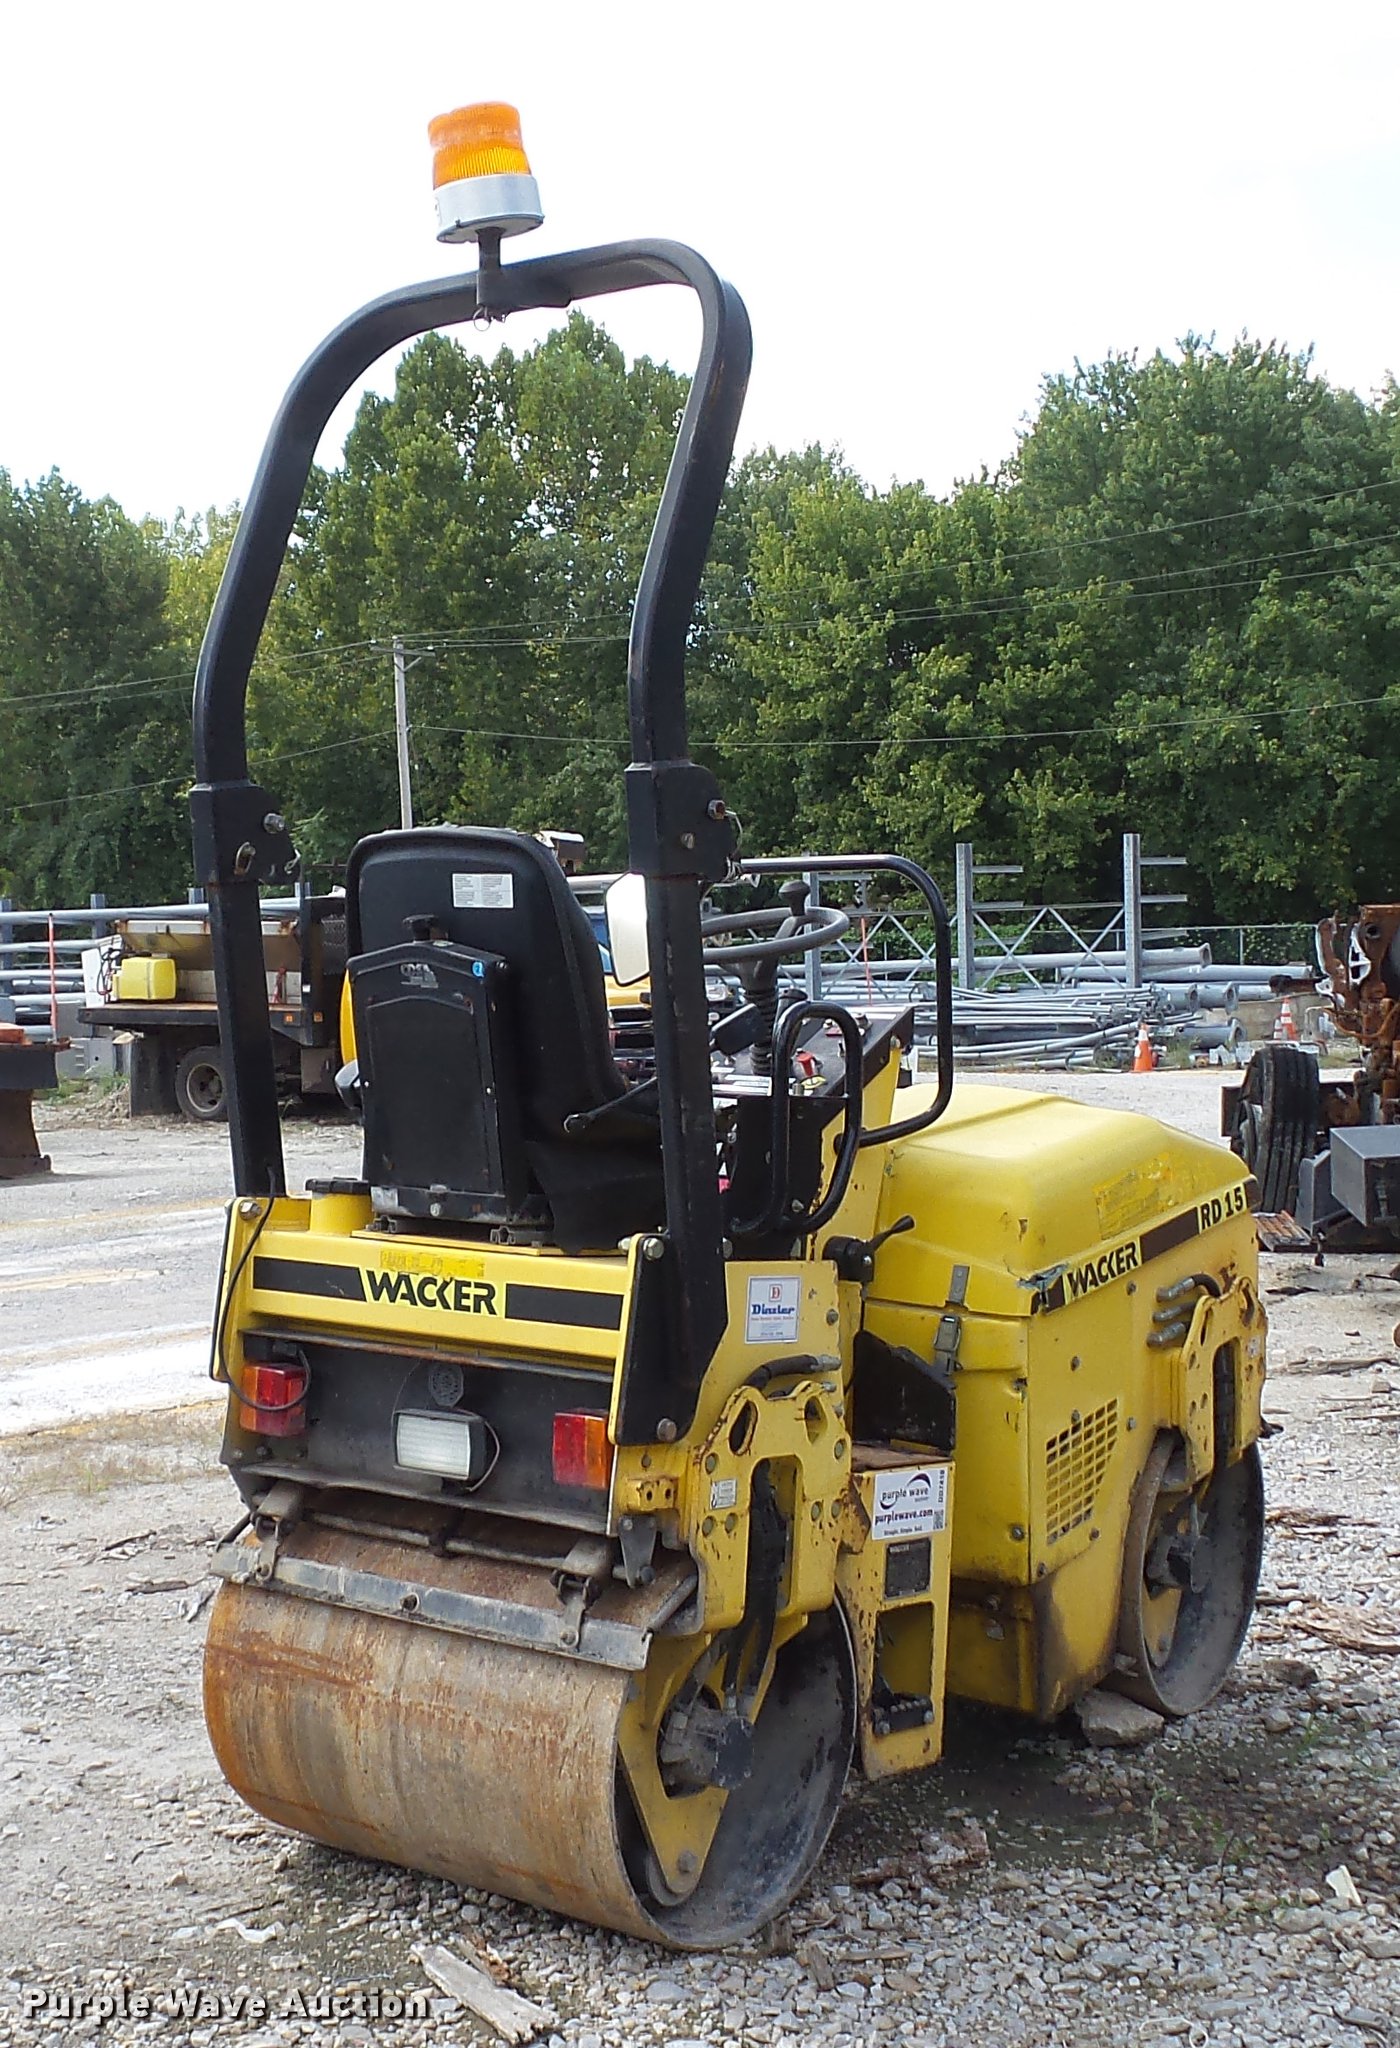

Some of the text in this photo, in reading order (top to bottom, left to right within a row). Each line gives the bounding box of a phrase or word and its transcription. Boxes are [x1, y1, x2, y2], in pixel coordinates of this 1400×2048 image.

[1201, 1186, 1244, 1231] RD 15
[366, 1269, 497, 1316] WACKER
[1067, 1242, 1139, 1298] WACKER
[881, 1488, 907, 1501] purple
[909, 1487, 929, 1497] wave
[875, 1508, 934, 1526] purplewave.com
